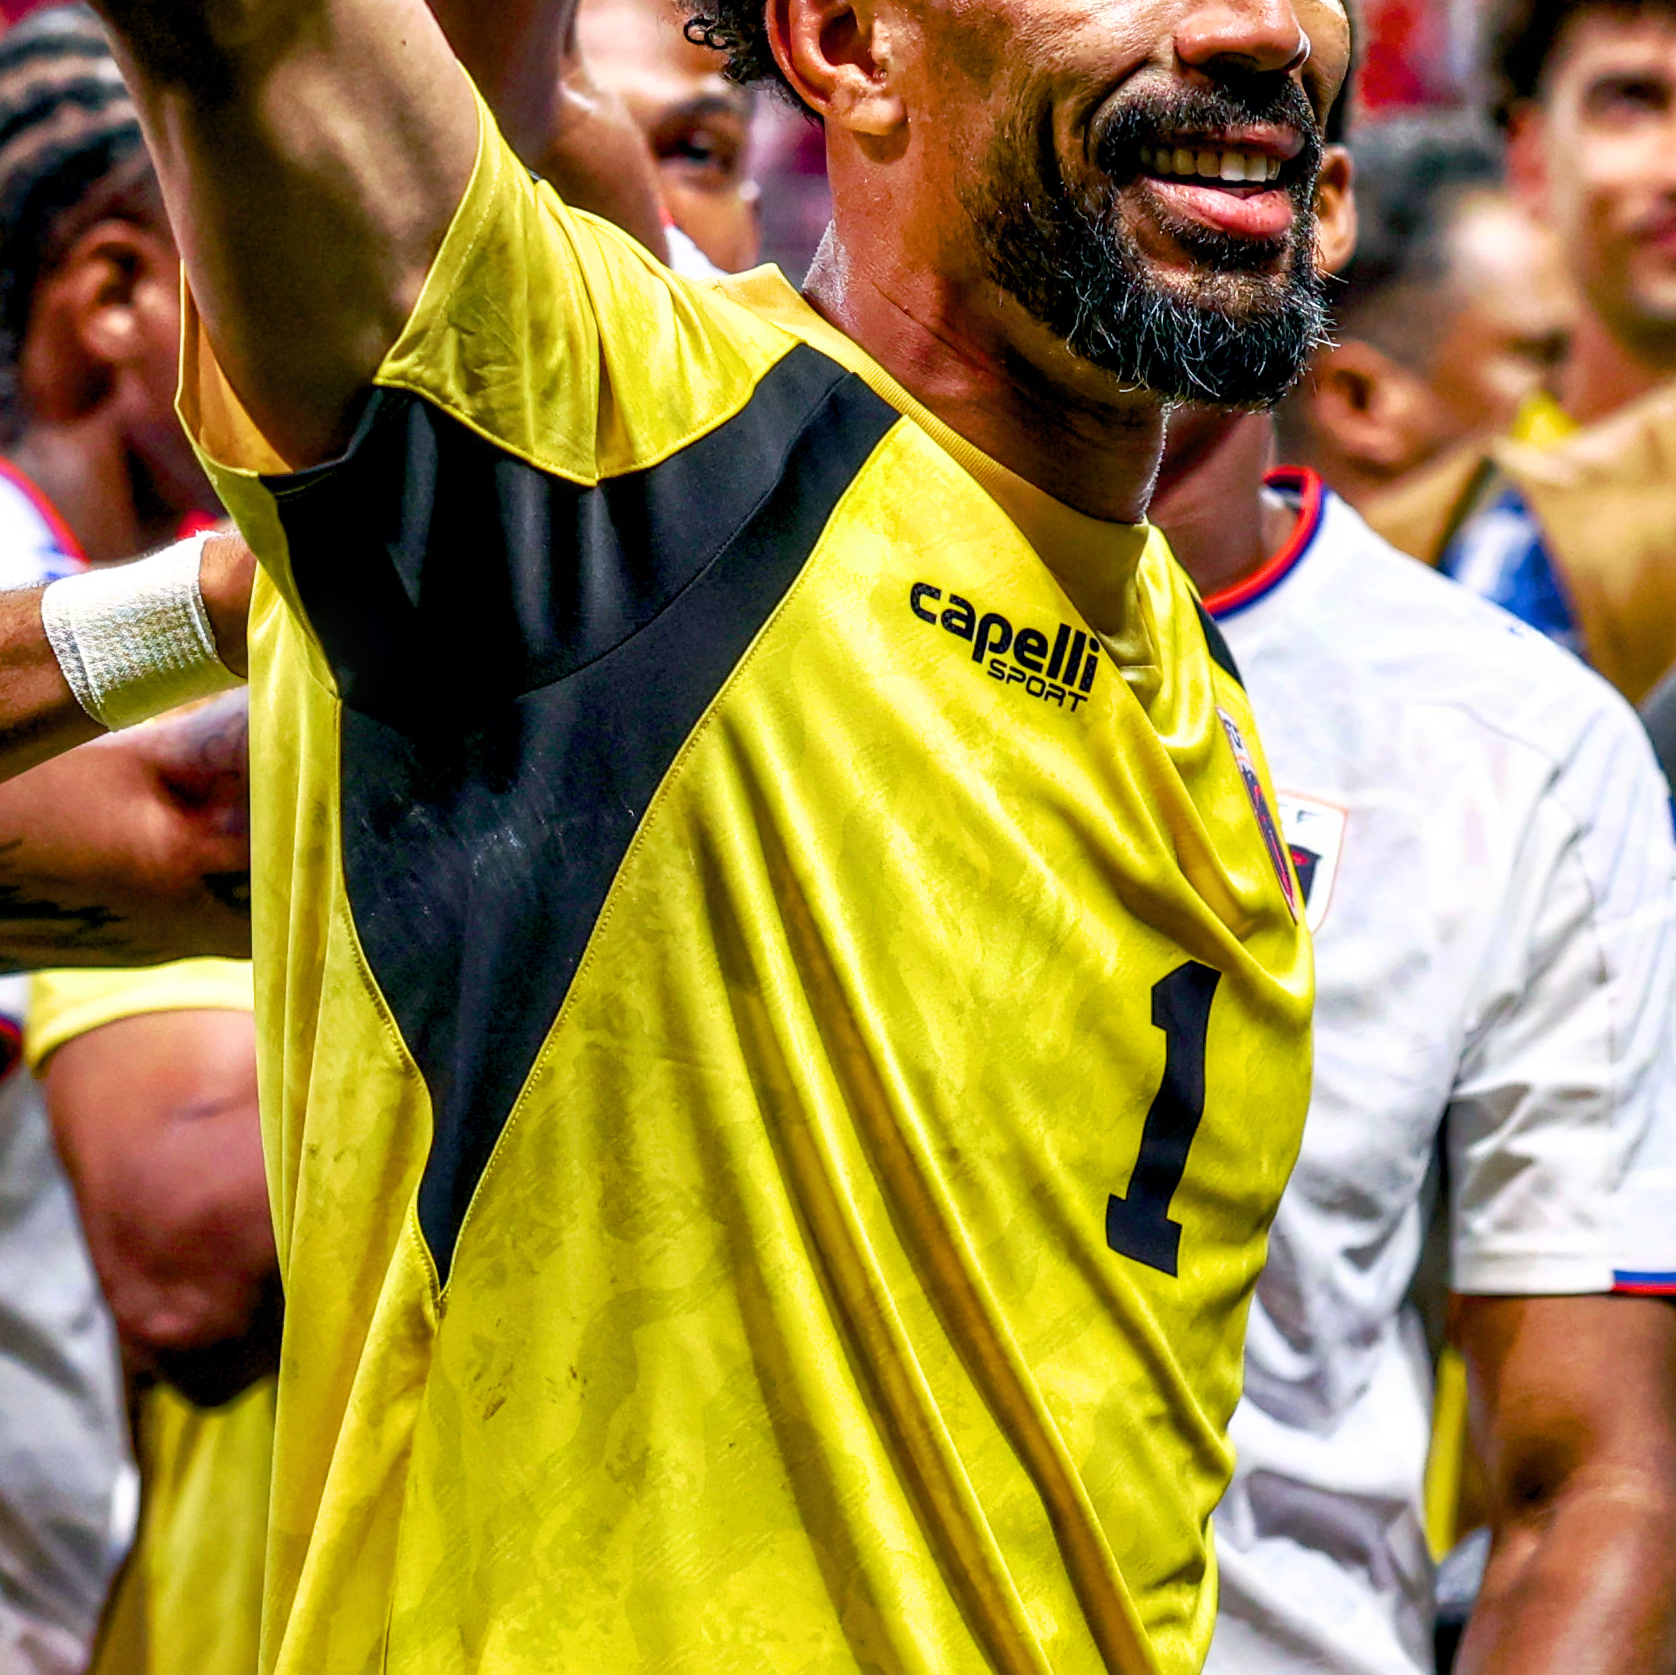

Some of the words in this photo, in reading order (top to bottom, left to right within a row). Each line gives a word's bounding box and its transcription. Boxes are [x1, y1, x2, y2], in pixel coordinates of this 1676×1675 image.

[910, 581, 1101, 694] capelli
[987, 658, 1088, 713] SPORT
[1106, 959, 1222, 1278] 1
